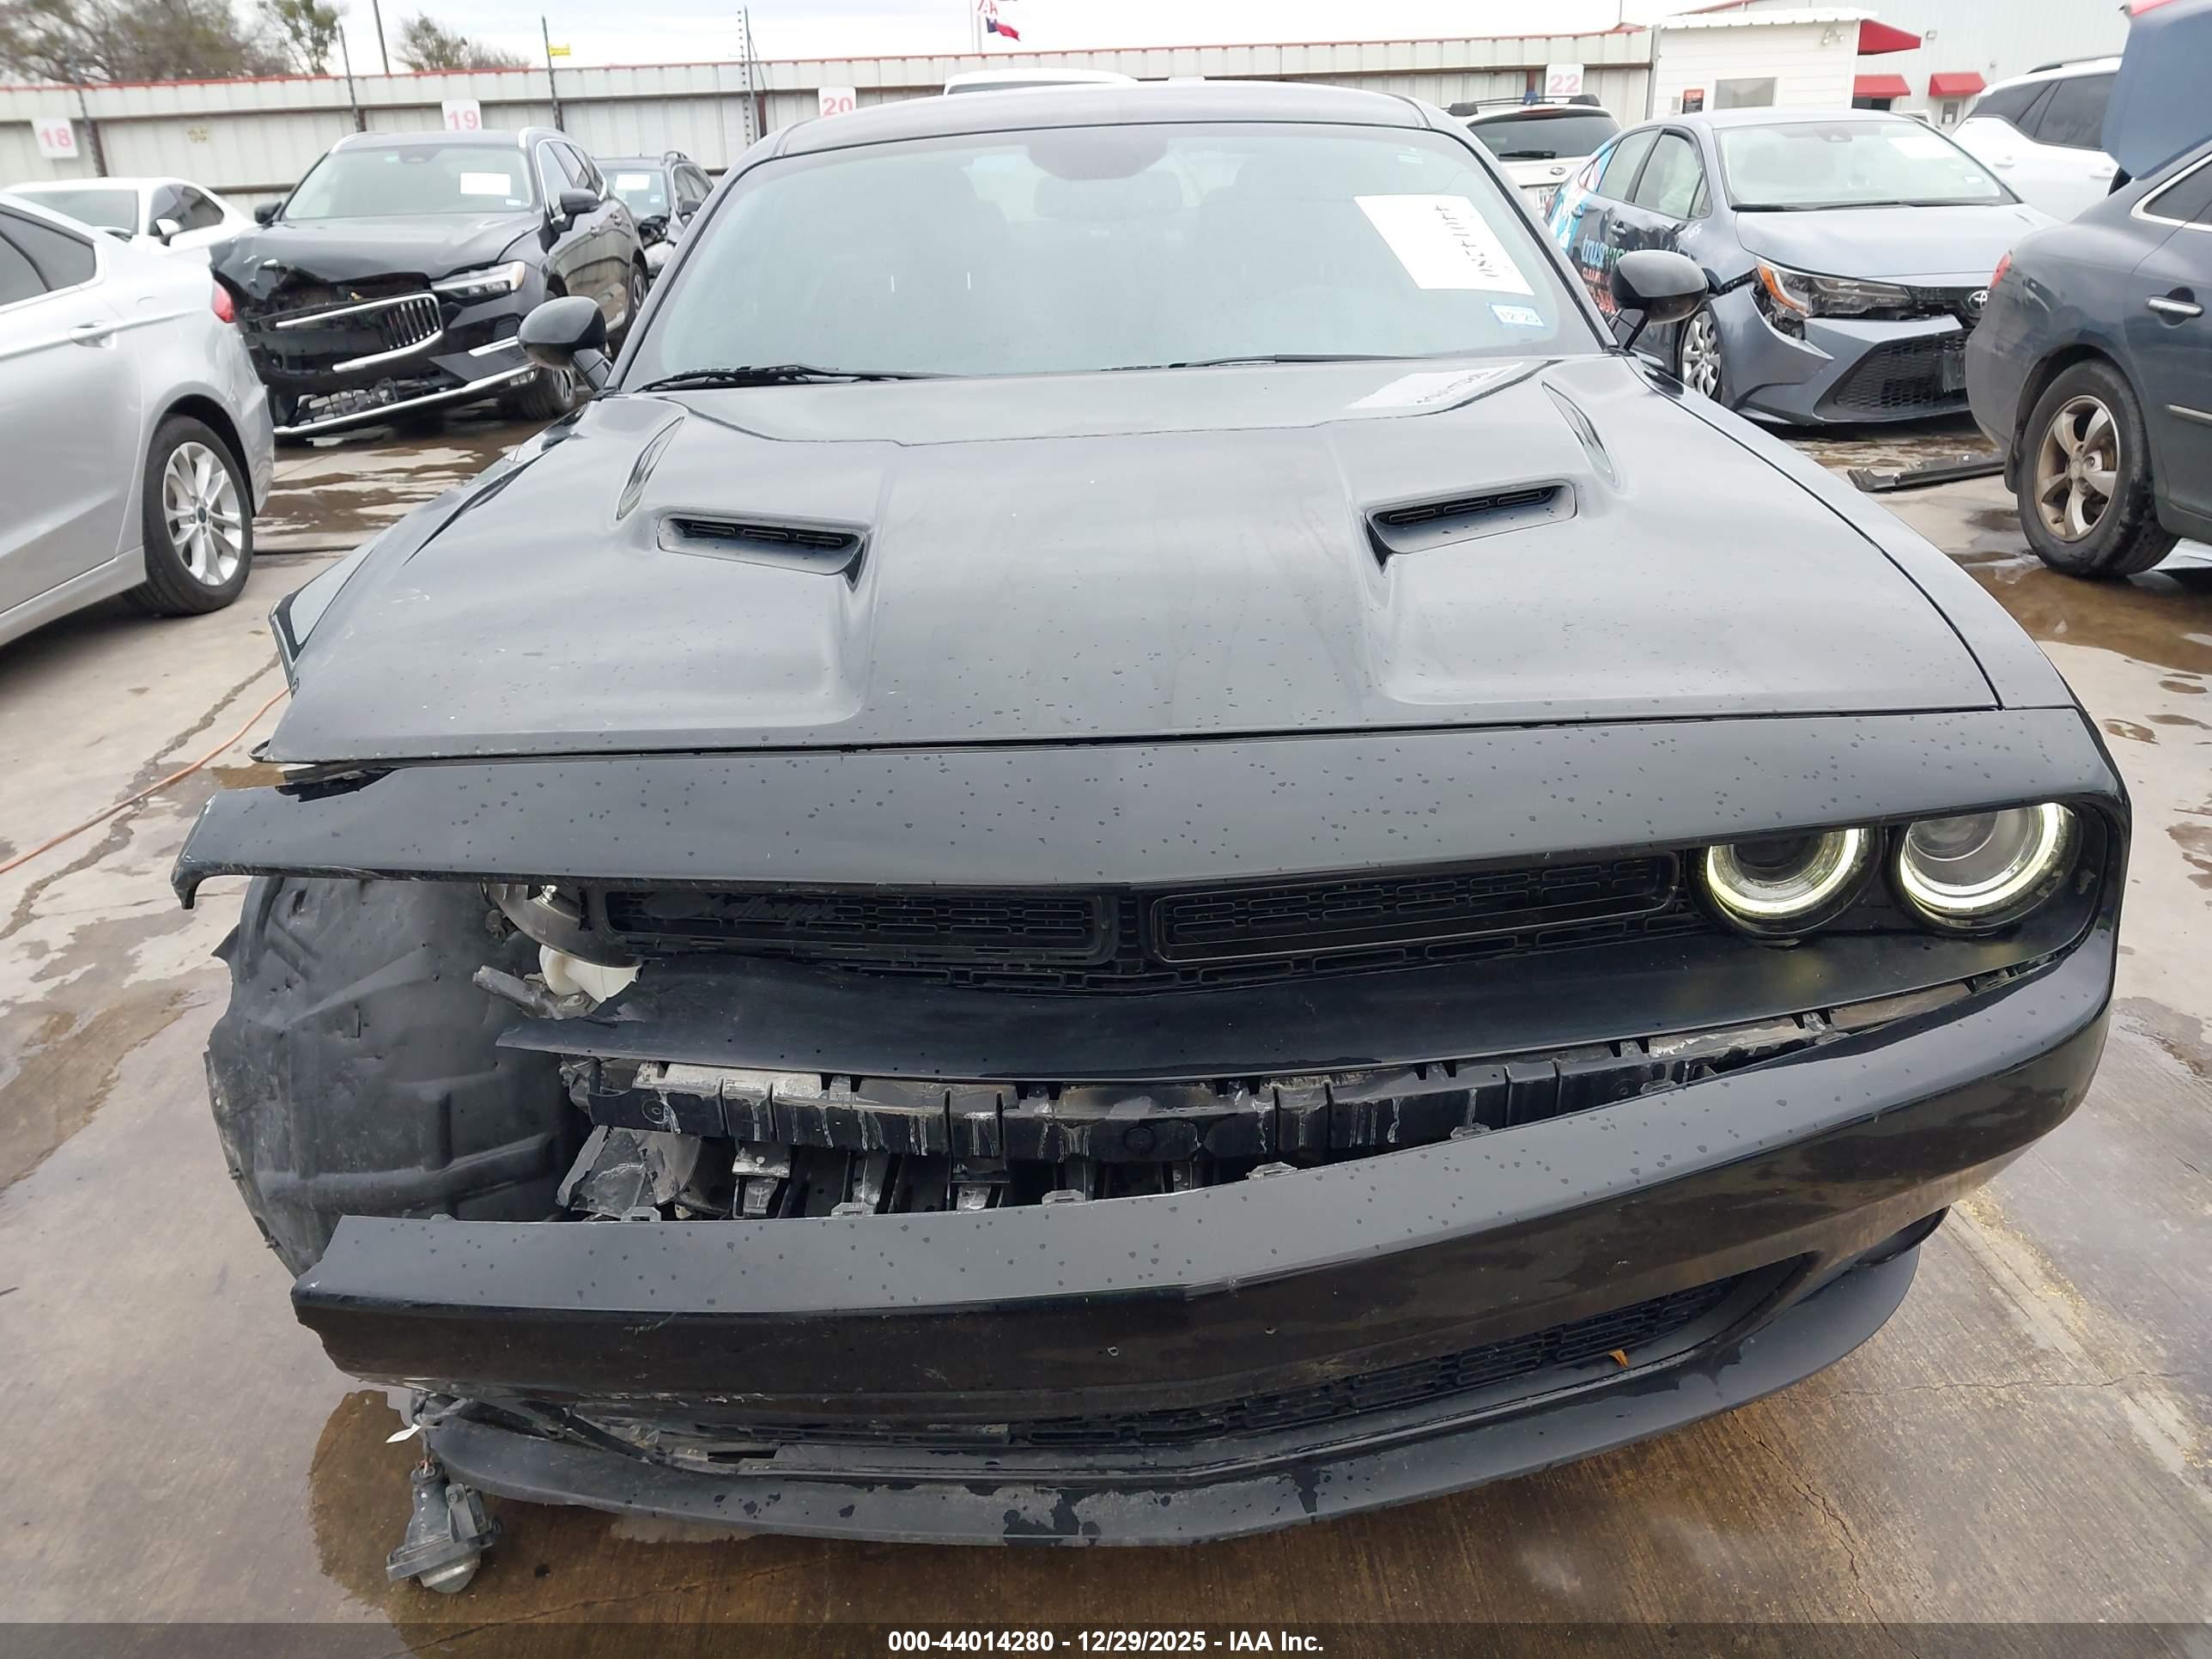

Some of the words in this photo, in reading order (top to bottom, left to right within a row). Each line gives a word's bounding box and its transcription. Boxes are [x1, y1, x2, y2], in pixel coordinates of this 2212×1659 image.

[1549, 74, 1580, 94] 22
[823, 96, 854, 116] 20
[448, 110, 478, 130] 19
[40, 128, 72, 148] 18
